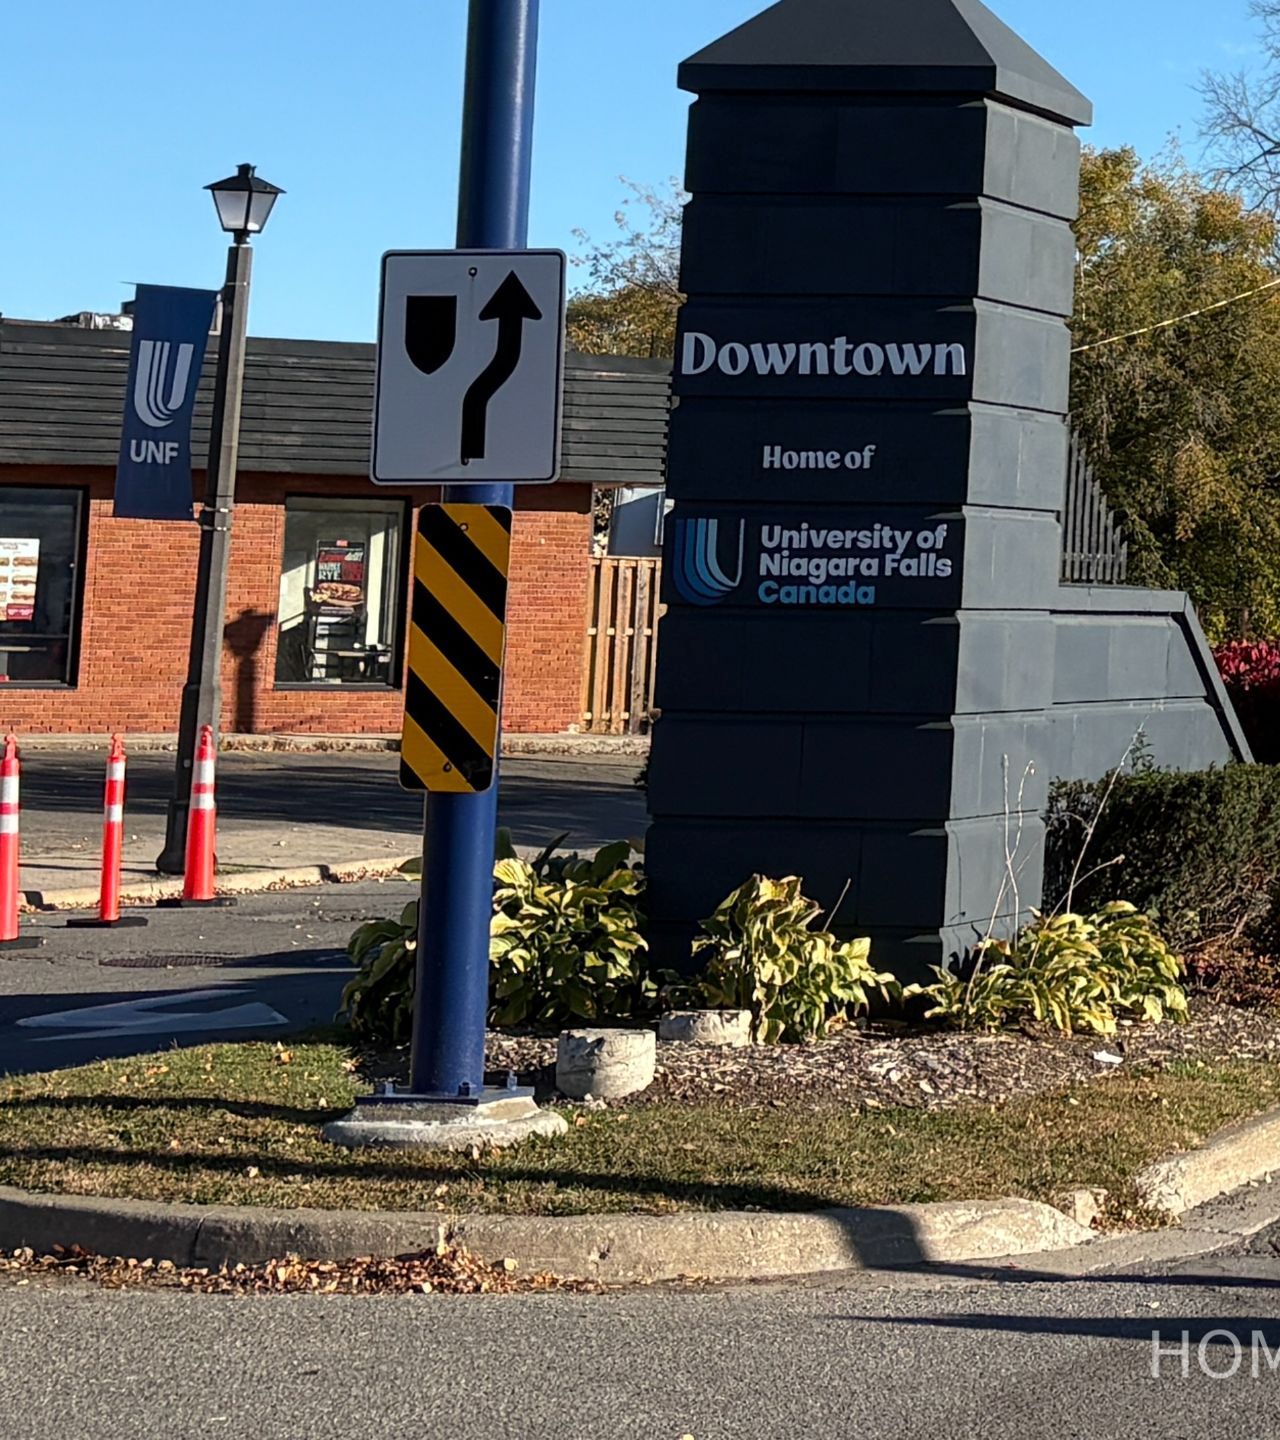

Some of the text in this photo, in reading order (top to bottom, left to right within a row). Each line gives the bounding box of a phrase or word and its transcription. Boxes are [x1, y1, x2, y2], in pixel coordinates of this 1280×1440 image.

[681, 332, 966, 375] Downtown
[130, 439, 179, 464] UNF
[762, 445, 876, 469] Home of
[761, 522, 948, 555] University of
[759, 549, 952, 585] Niagara Falls
[758, 580, 876, 605] Canada
